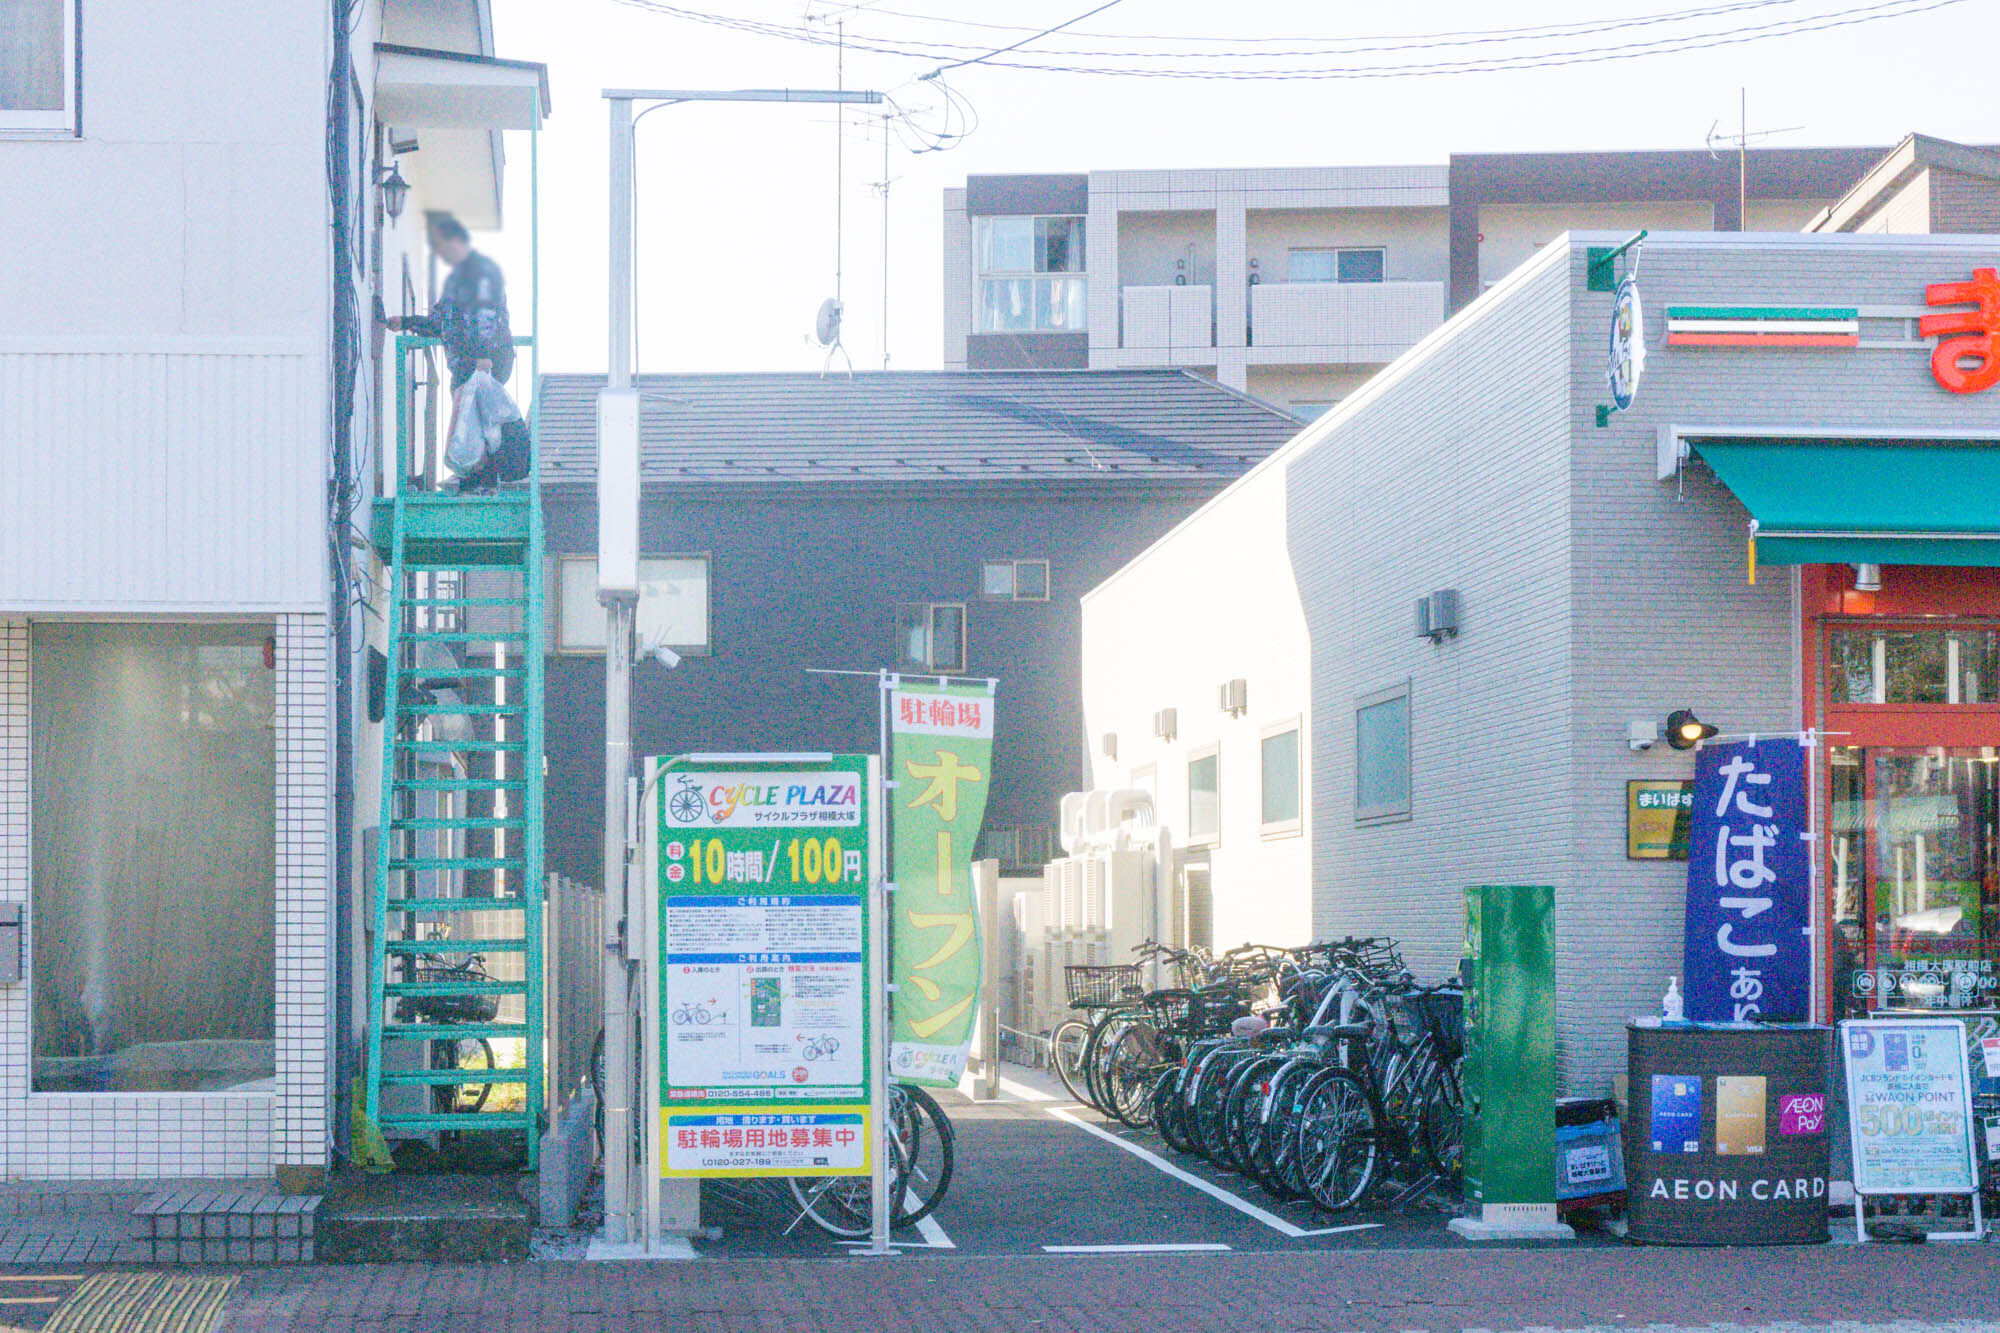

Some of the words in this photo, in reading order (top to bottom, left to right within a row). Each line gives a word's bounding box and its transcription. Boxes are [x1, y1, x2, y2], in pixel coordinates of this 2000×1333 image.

[900, 697, 981, 729] 駐輪場
[708, 784, 779, 817] CYCLE
[785, 785, 856, 806] PLAZA
[1875, 1092, 1914, 1102] WAON
[1918, 1091, 1956, 1102] POINT
[1798, 1115, 1823, 1131] Pay
[1860, 1104, 1923, 1136] 500
[677, 1128, 856, 1150] 駐輪場用地募集中
[1746, 1145, 1763, 1153] VISA
[1650, 1178, 1738, 1201] AEON
[1751, 1177, 1826, 1200] CARD
